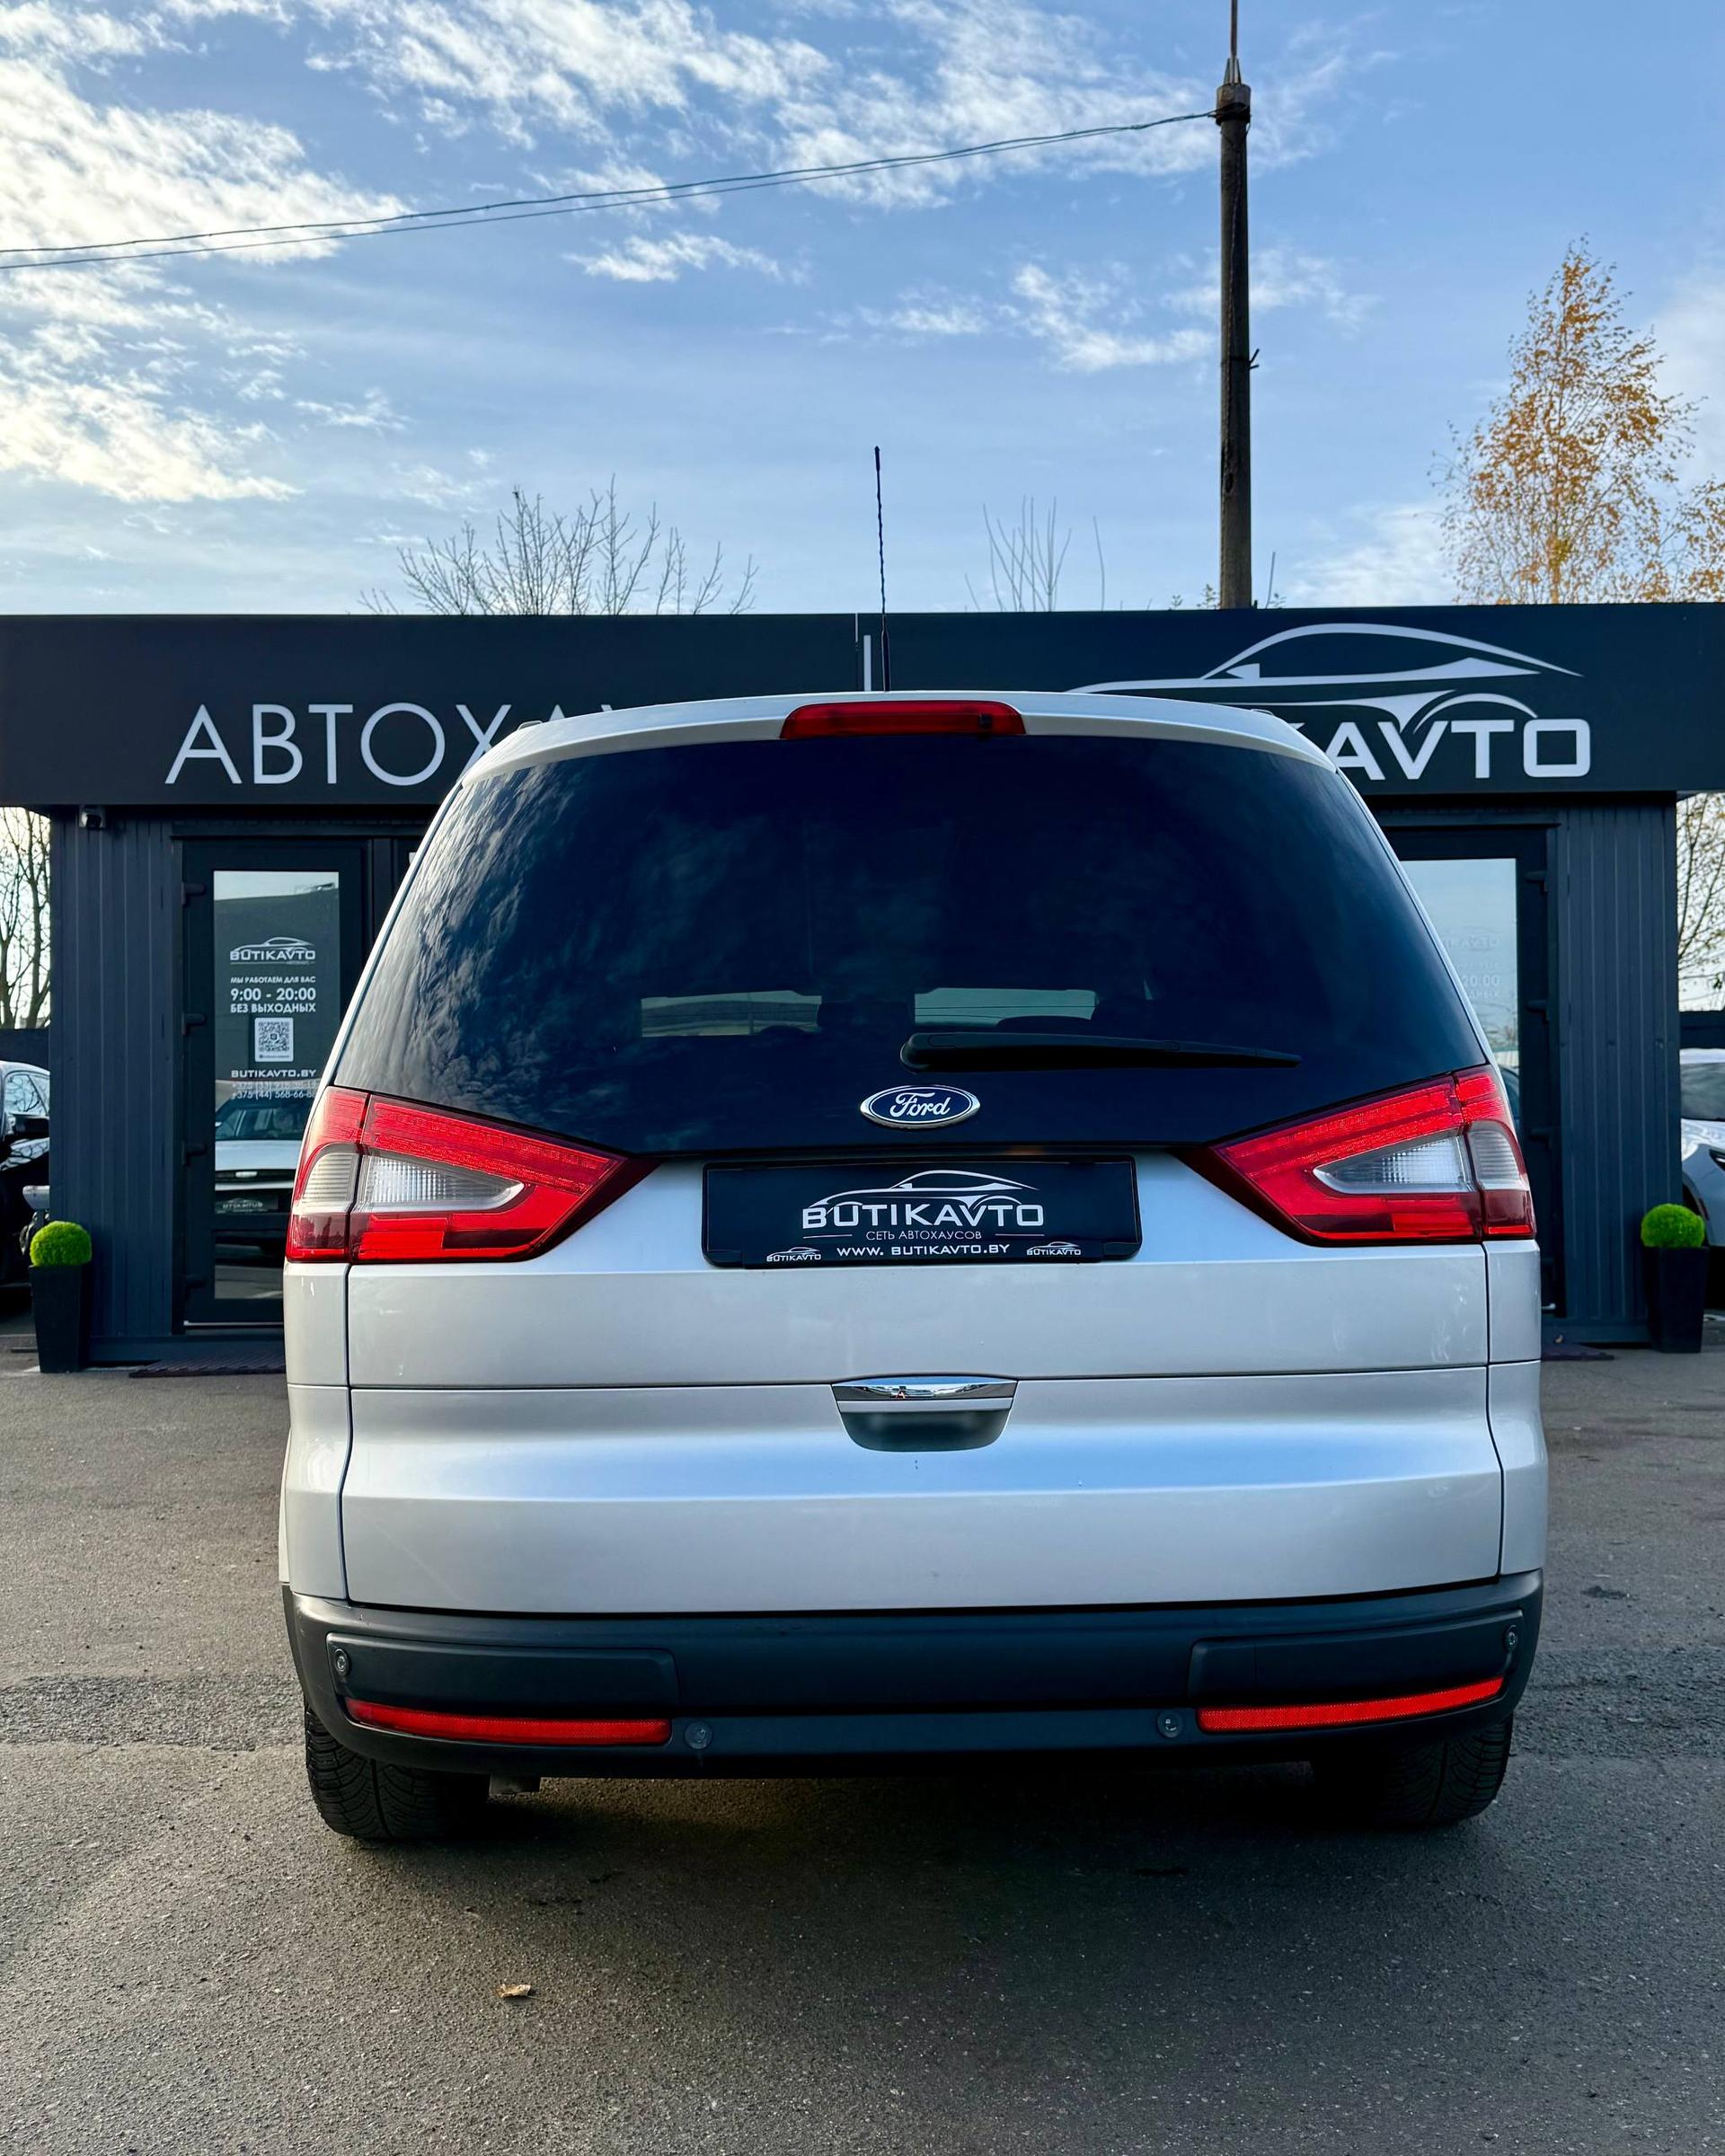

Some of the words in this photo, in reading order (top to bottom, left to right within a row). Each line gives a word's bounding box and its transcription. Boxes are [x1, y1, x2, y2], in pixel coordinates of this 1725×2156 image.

[165, 702, 615, 786] АВТОХ
[1295, 719, 1591, 780] AVTO
[230, 950, 316, 960] BUTIKAVTO
[231, 988, 261, 1001] 9:00
[276, 987, 316, 1001] 20:00
[230, 1003, 248, 1013] БЕЗ
[252, 1003, 316, 1013] ВЫХОДНЫХ
[231, 1070, 316, 1078] BUTIKAVTO.BY
[889, 1091, 952, 1118] Ford
[802, 1203, 1044, 1229] BUTIKAVTO
[865, 1232, 895, 1241] СЕТЬ
[898, 1230, 982, 1241] АВТОХАУСОВ
[836, 1247, 884, 1257] WWW.
[891, 1243, 1010, 1256] BUTIKAVTO.BY
[766, 1253, 821, 1262] BUTIKAVTO
